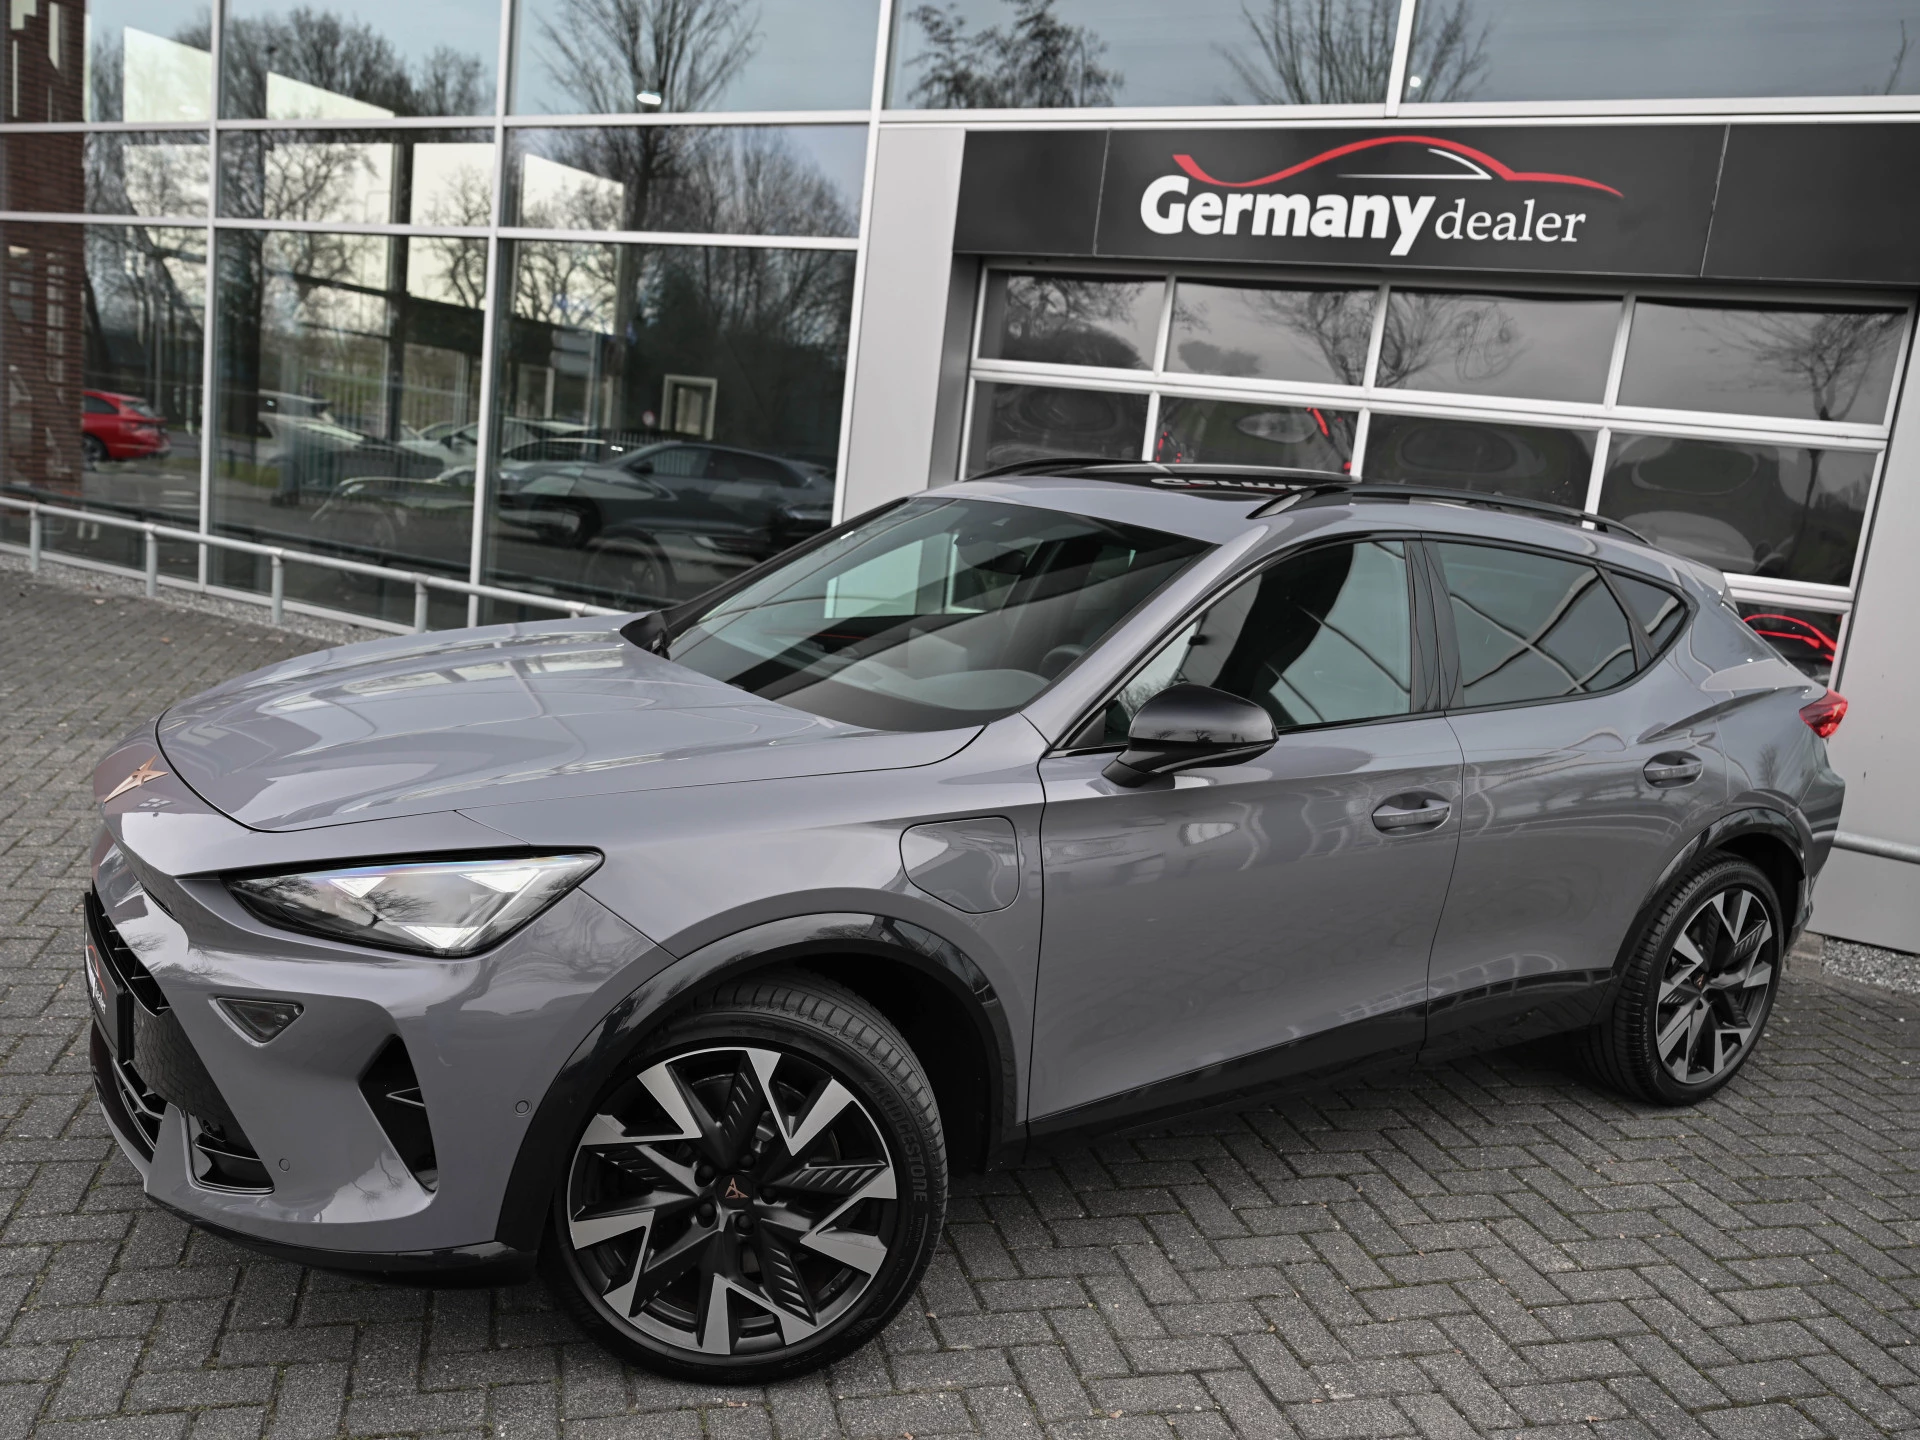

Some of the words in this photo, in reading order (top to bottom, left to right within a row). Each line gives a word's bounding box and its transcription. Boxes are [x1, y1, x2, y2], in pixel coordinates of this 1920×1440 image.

[1140, 174, 1436, 256] Germany
[1434, 198, 1586, 242] dealer
[1642, 1006, 1651, 1064] TURANZA
[863, 1078, 929, 1202] BRIDGESTONE
